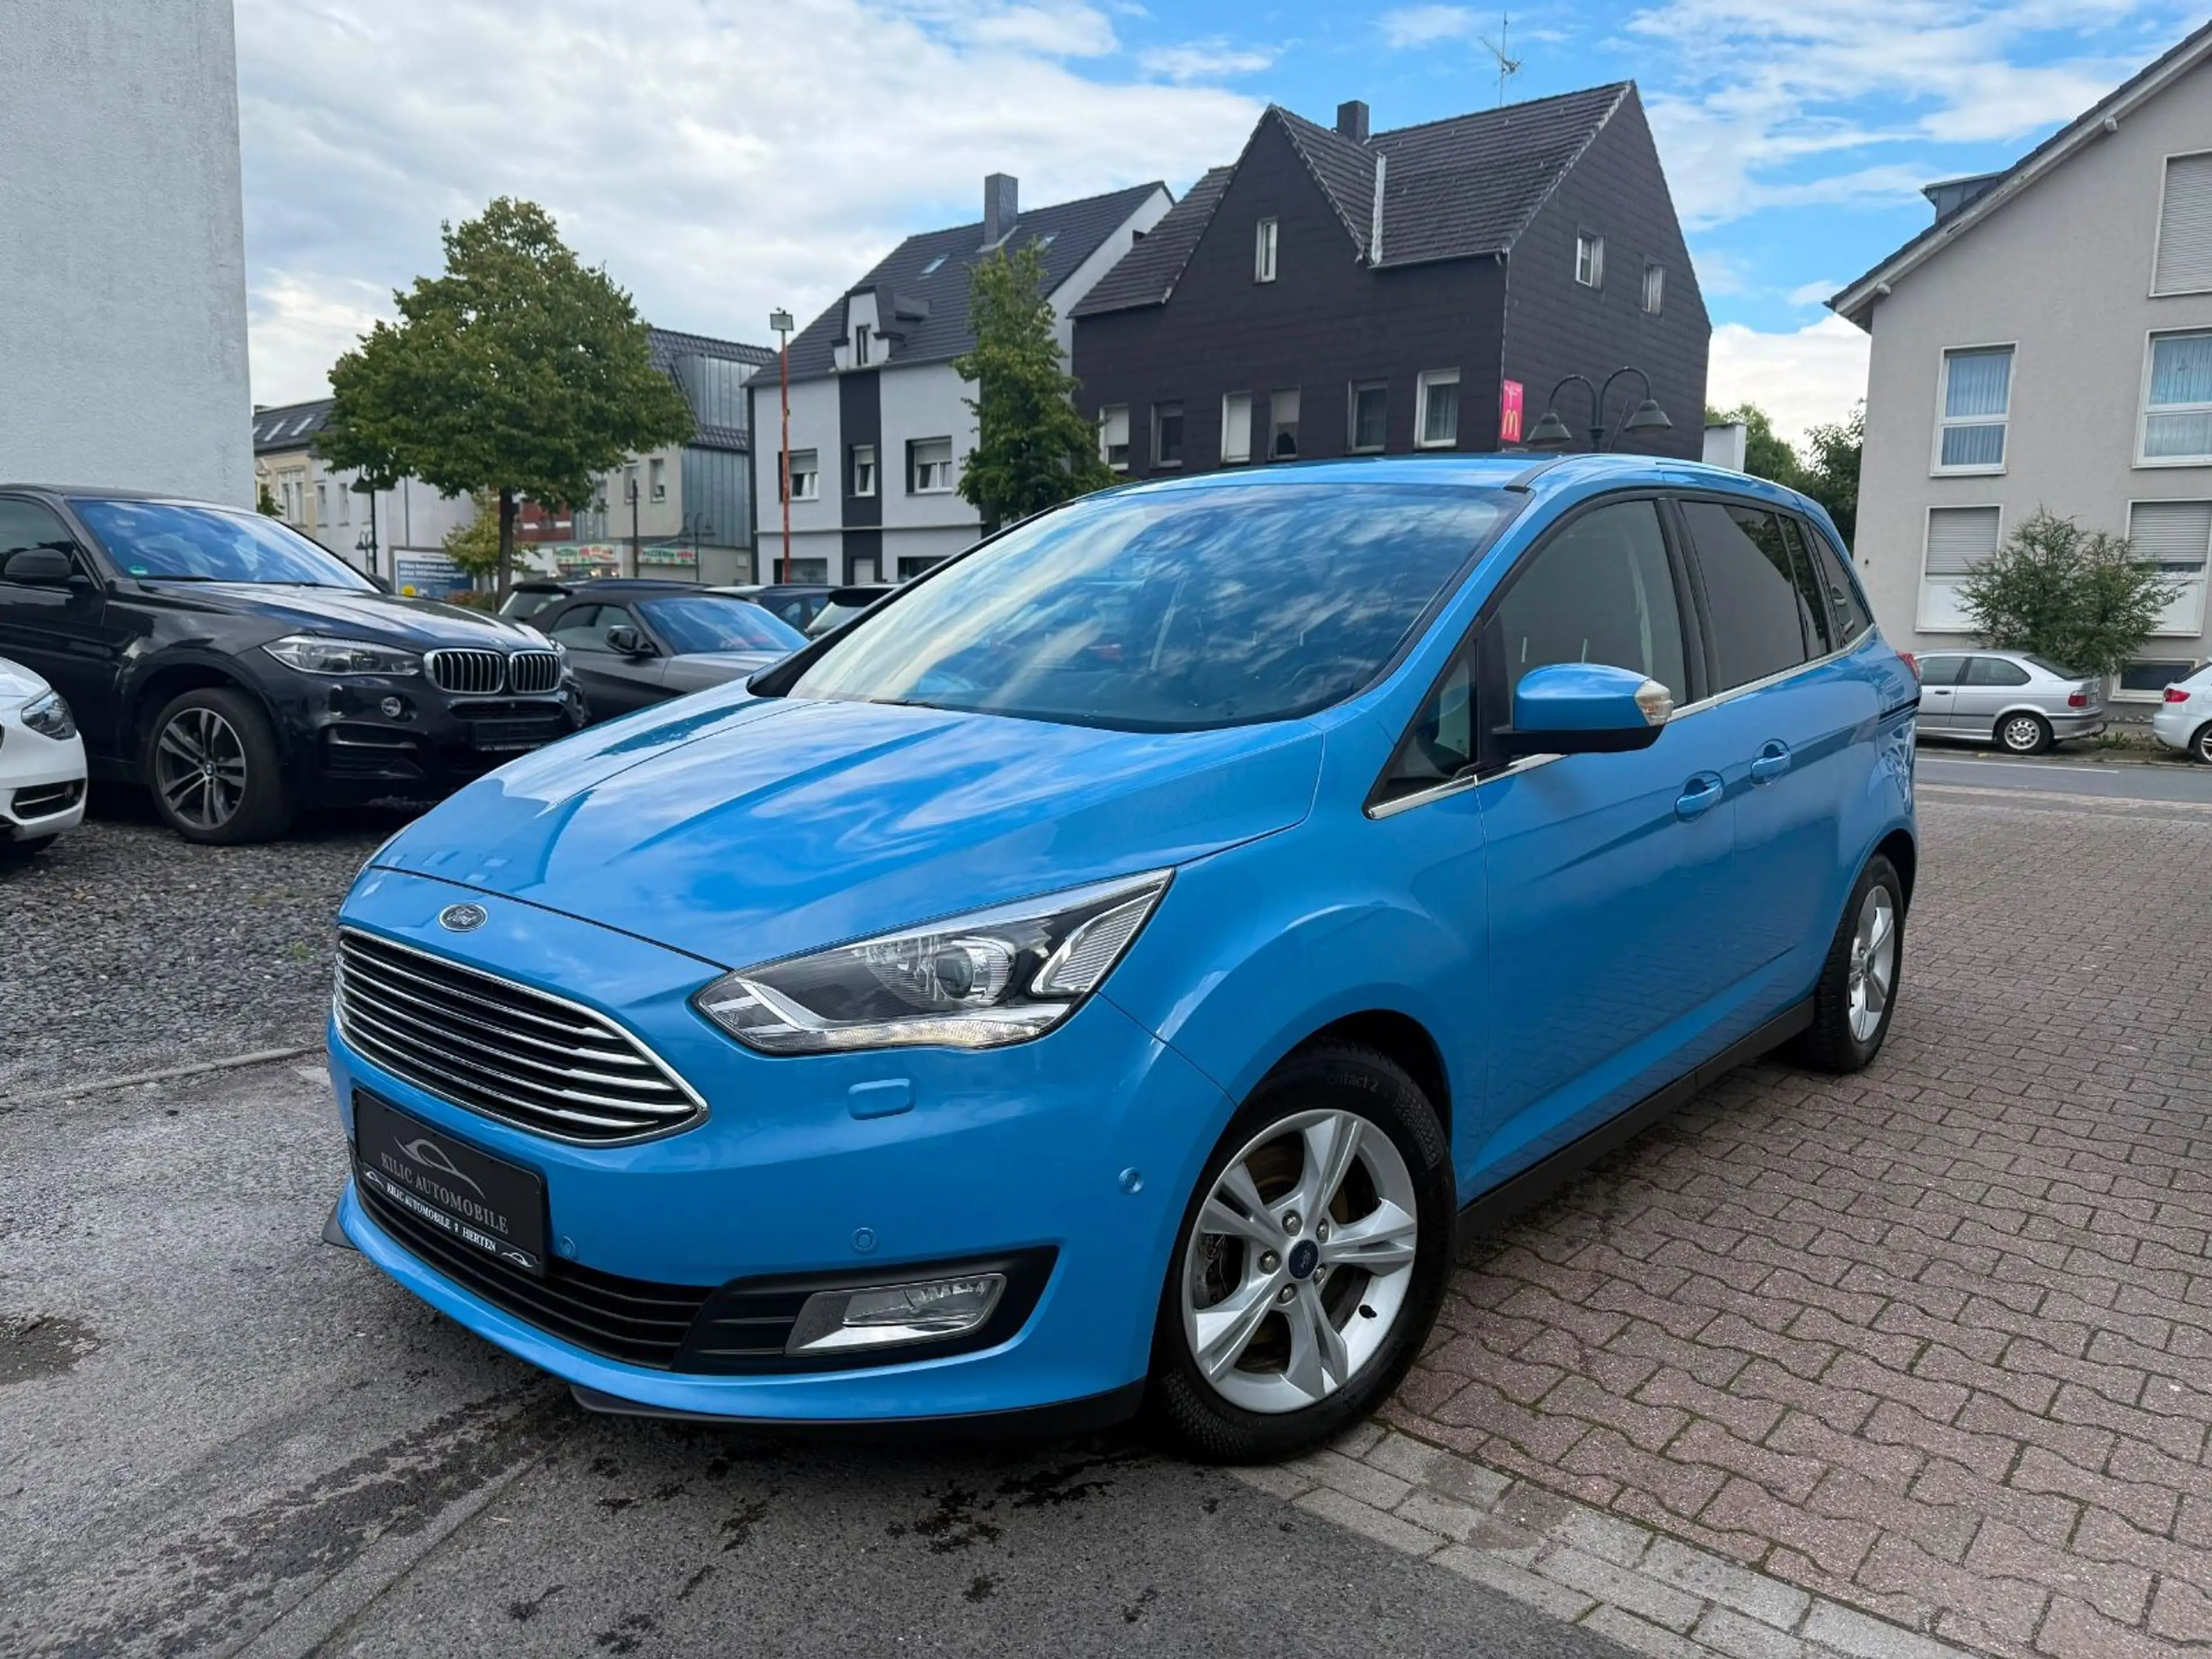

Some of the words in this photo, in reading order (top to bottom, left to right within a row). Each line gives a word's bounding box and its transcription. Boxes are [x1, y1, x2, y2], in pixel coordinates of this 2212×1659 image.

[381, 1151, 413, 1184] KILIC
[416, 1173, 509, 1234] AUTOMOBILE
[463, 1226, 496, 1253] HERTEN
